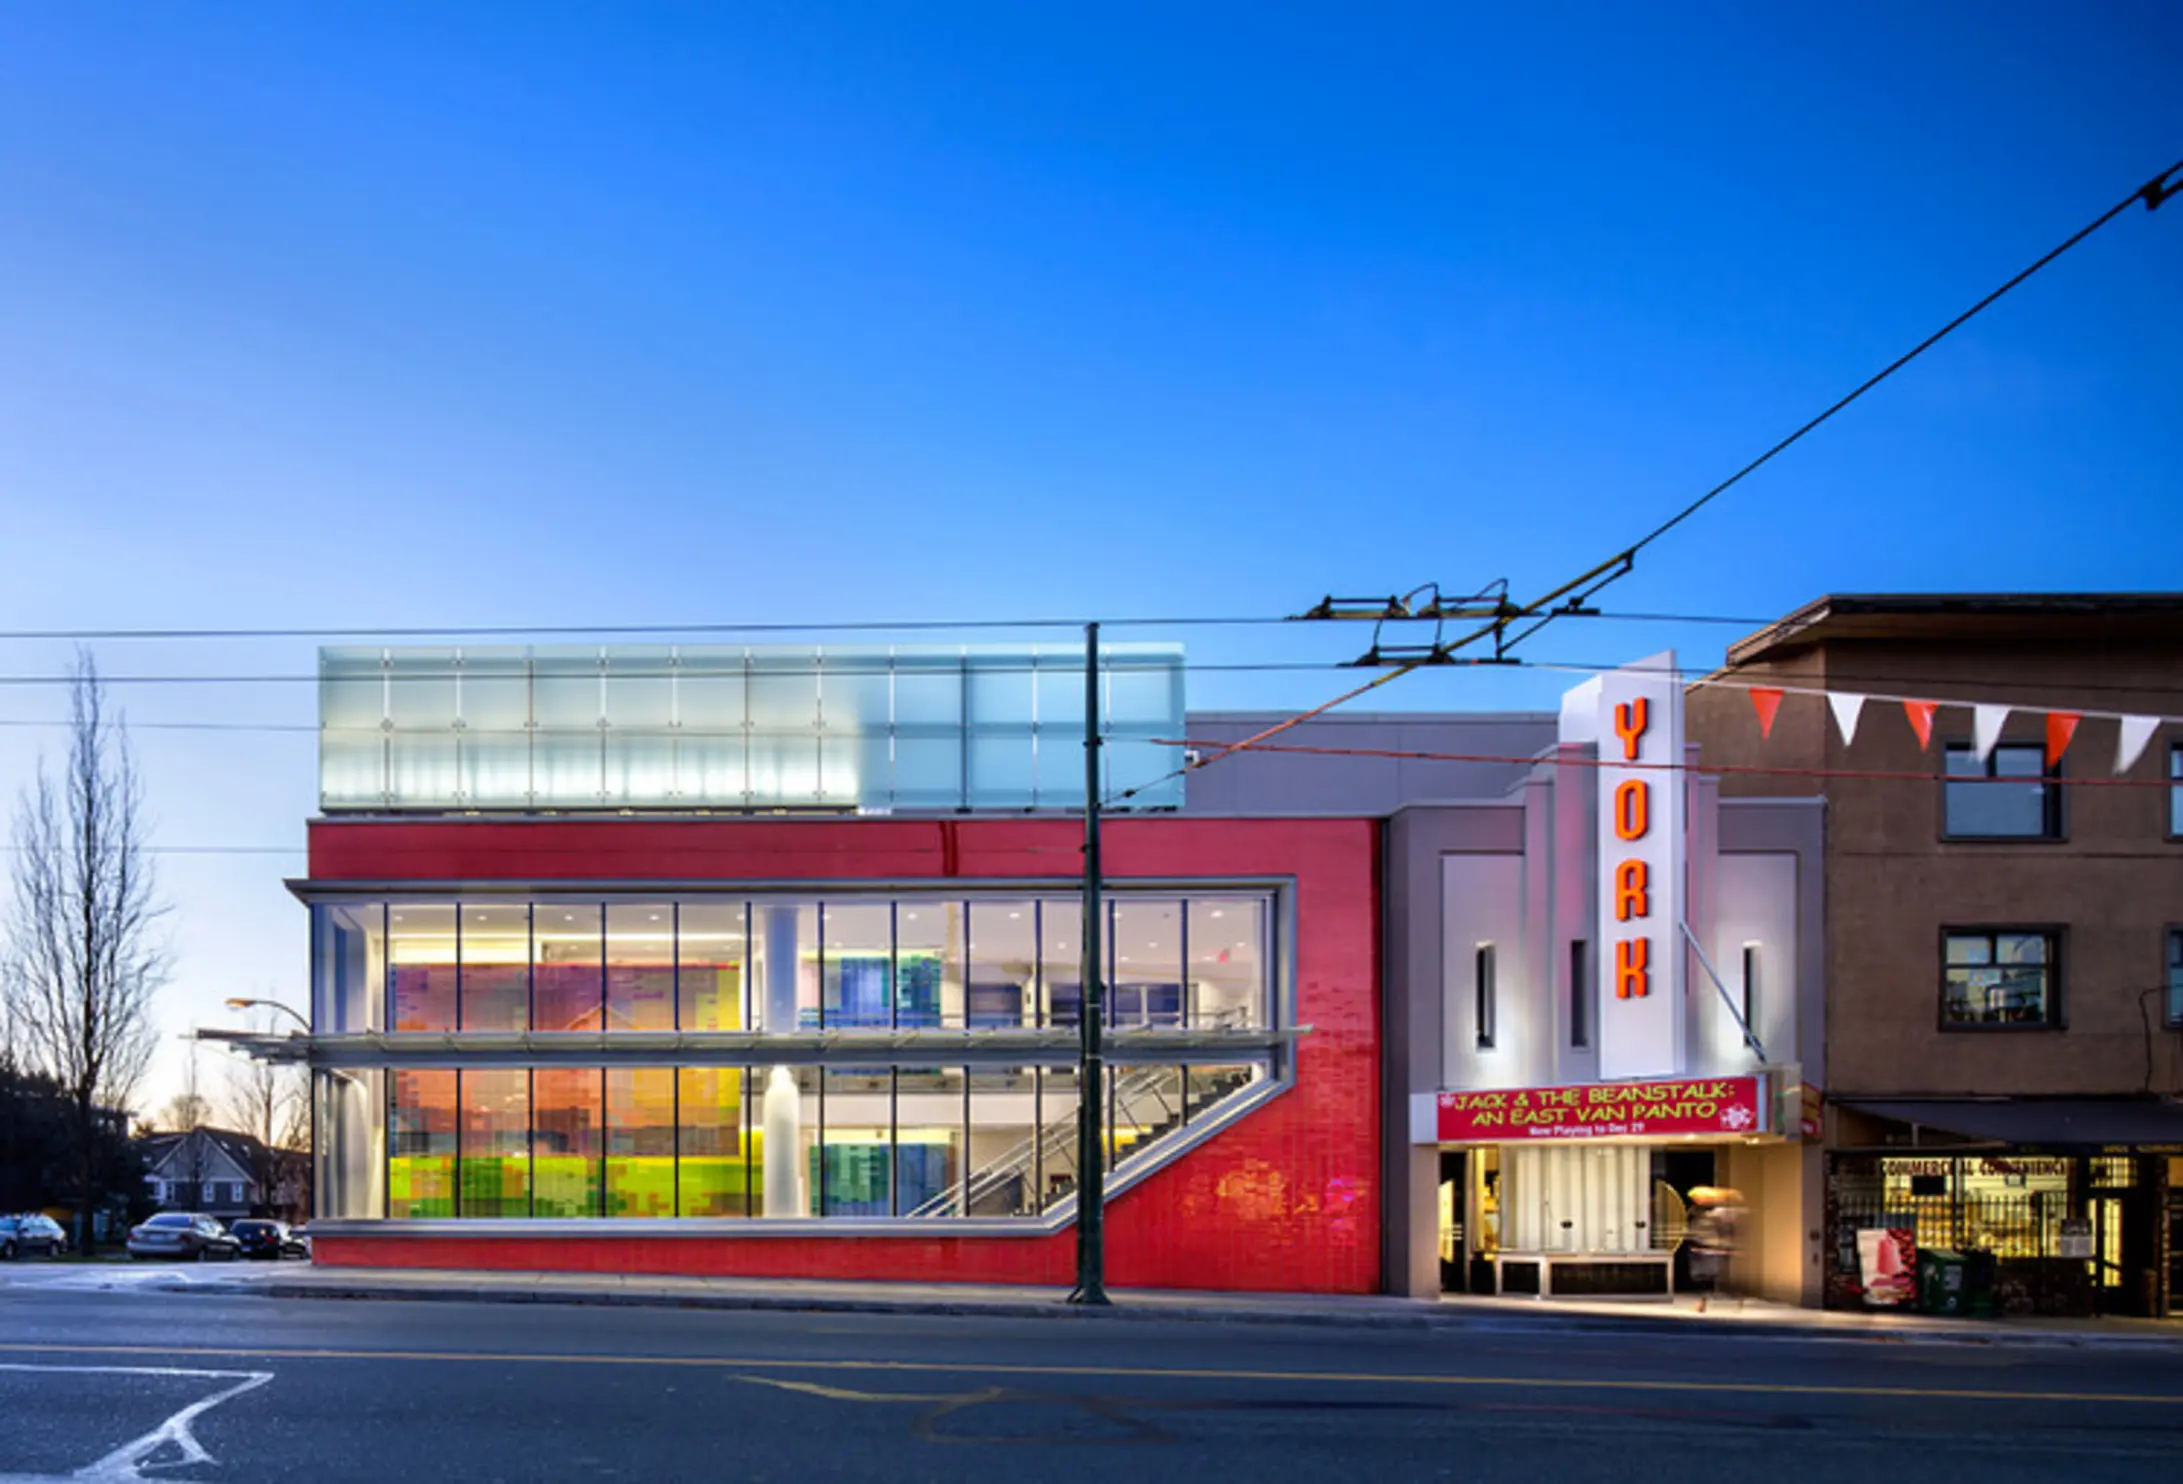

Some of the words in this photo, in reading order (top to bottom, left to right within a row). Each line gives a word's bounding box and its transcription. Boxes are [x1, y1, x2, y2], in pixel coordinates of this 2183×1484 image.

[1614, 696, 1649, 999] YORK
[1455, 1093, 1508, 1110] JACK
[1513, 1091, 1529, 1107] &
[1536, 1088, 1580, 1106] THE
[1472, 1110, 1504, 1126] AN
[1510, 1108, 1569, 1125] EAST
[1575, 1105, 1625, 1122] VAN
[1632, 1101, 1718, 1119] PANTO
